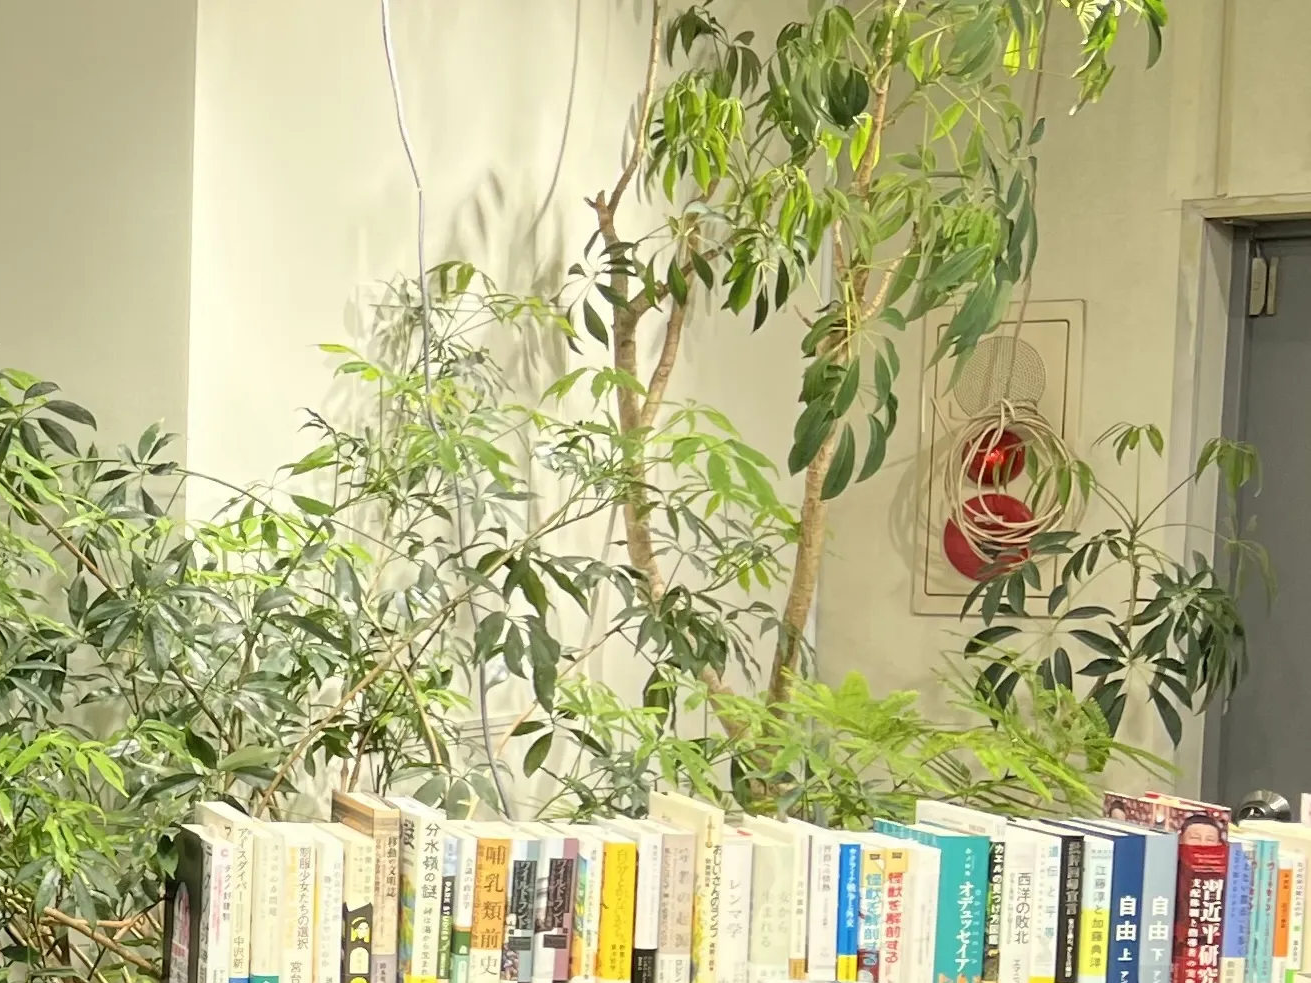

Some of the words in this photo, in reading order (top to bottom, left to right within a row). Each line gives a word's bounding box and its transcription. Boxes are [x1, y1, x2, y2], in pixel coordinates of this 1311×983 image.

[421, 822, 441, 899] 分水嶺の謎
[297, 846, 313, 950] 制服少女たちの選択
[480, 844, 507, 976] 哺乳類前史
[728, 879, 742, 939] レンマ学
[885, 871, 903, 964] 怪獣を解剖する
[954, 880, 975, 973] オデュッセイア
[1015, 872, 1031, 945] 西洋の敗北
[1089, 865, 1107, 968] 江藤淳と加藤典洋
[1115, 895, 1137, 942] 自由
[1148, 895, 1170, 942] 自由
[233, 935, 245, 975] 中沢新一
[1117, 948, 1133, 962] 上
[1151, 948, 1165, 962] 下
